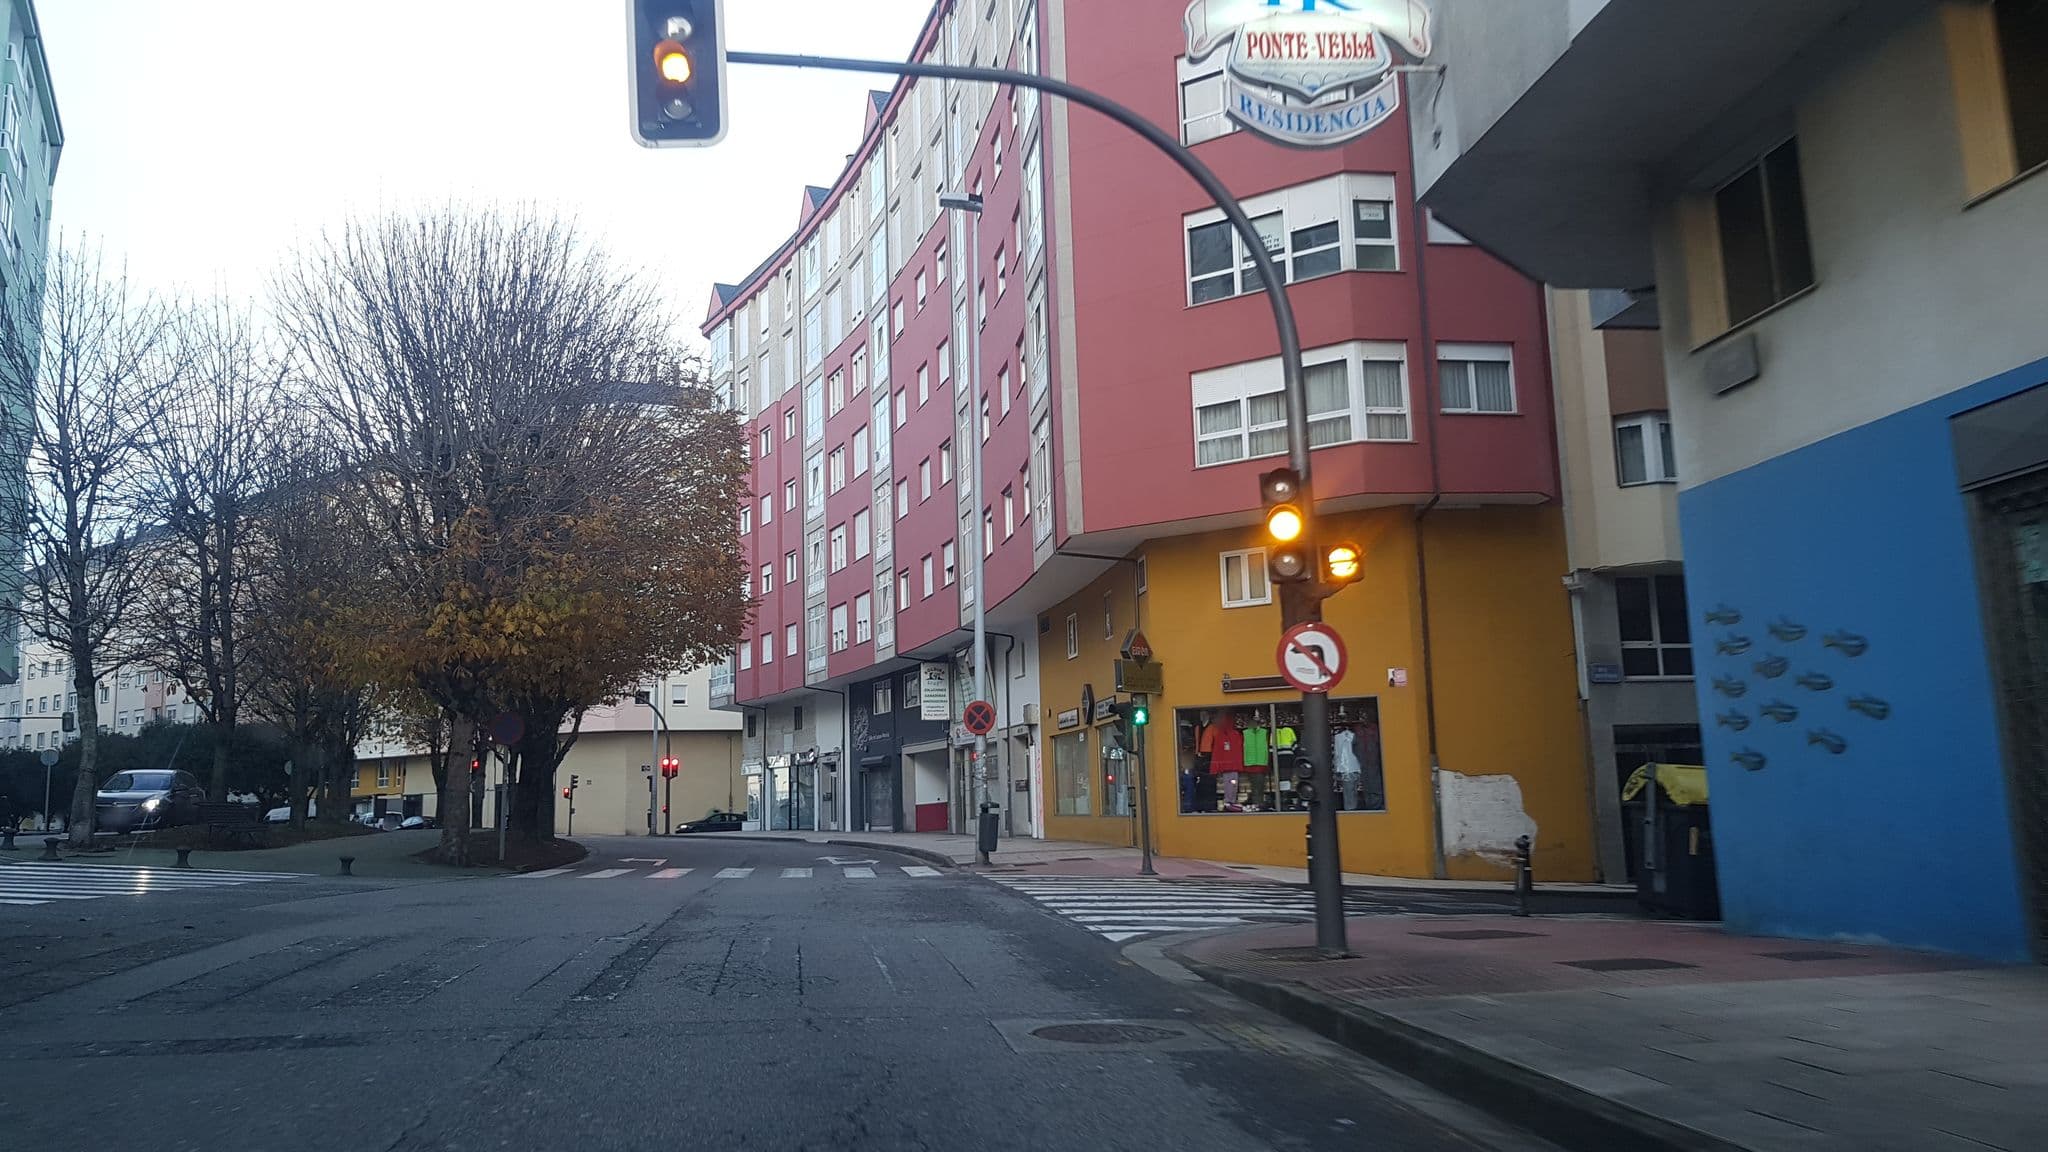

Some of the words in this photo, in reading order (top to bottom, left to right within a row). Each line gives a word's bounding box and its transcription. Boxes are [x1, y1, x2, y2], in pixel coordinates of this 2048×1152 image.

[1246, 31, 1309, 60] PONTE
[1315, 31, 1377, 60] VELLA
[1239, 93, 1387, 134] RESIDENCIA
